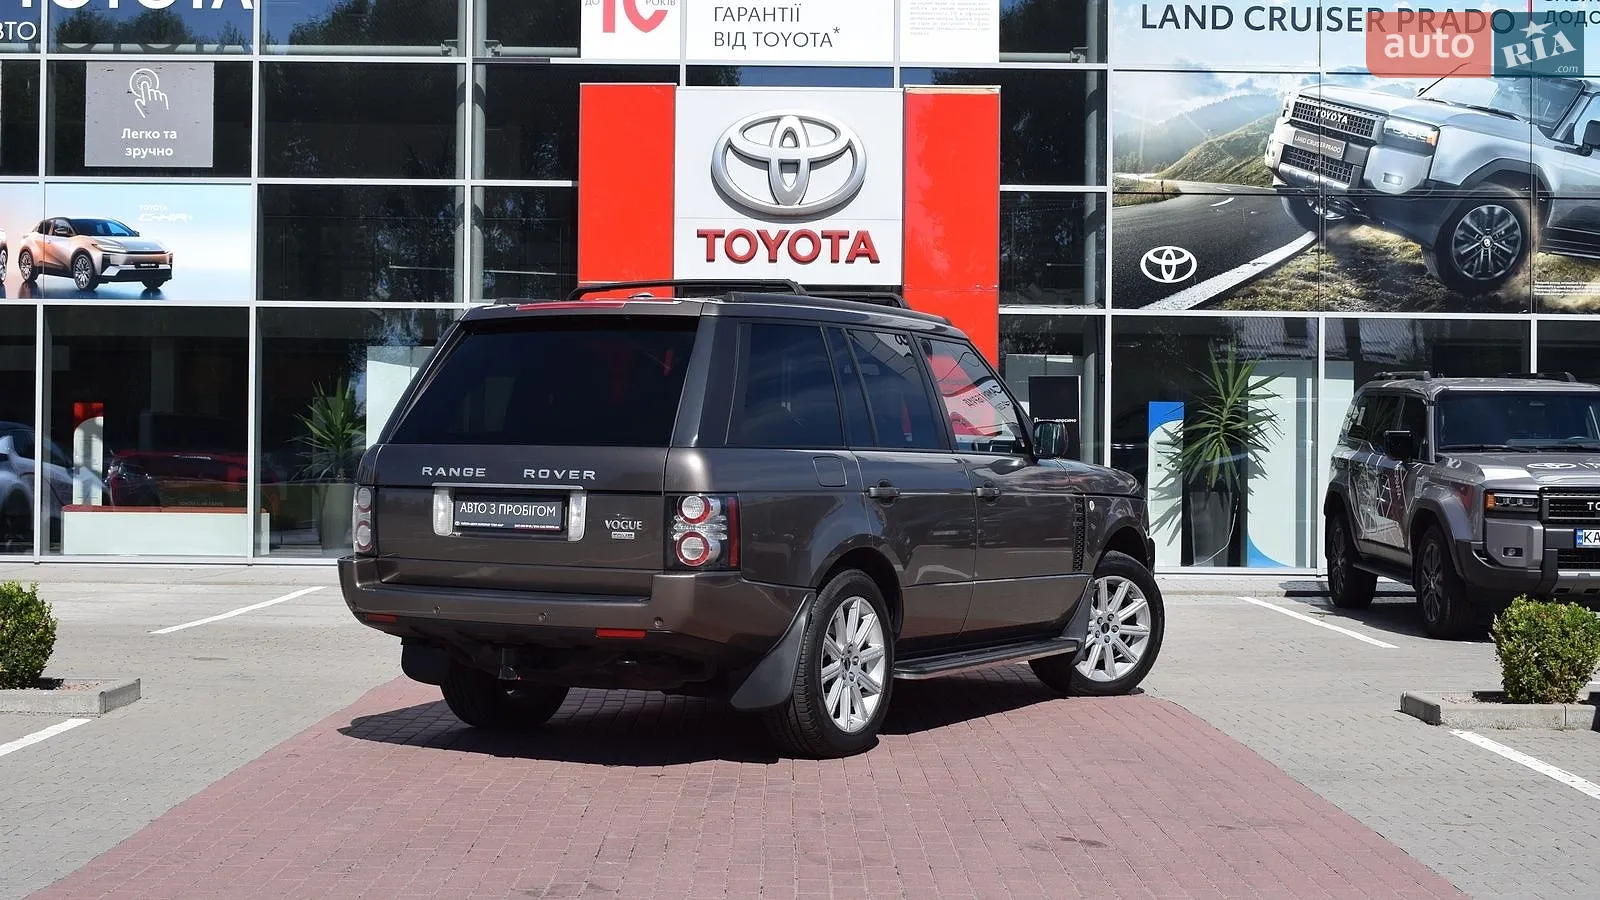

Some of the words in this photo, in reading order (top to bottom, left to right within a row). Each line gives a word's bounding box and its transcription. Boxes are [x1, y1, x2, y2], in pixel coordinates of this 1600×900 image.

[714, 3, 802, 22] ГАРАНТІЇ
[1141, 4, 1234, 30] LAND
[1243, 5, 1386, 33] CRUISER
[1397, 7, 1515, 35] PRADO
[714, 32, 747, 50] ВІД
[1315, 108, 1348, 124] TOYOTA
[121, 128, 160, 140] Легко
[163, 131, 177, 140] та
[125, 147, 174, 158] зручно
[697, 228, 880, 265] TOYOTA
[421, 466, 486, 478] RANGE
[523, 468, 596, 481] ROVER
[460, 502, 487, 514] АВТО
[498, 503, 556, 517] ПРОБІГОМ
[604, 519, 643, 531] VOGUE
